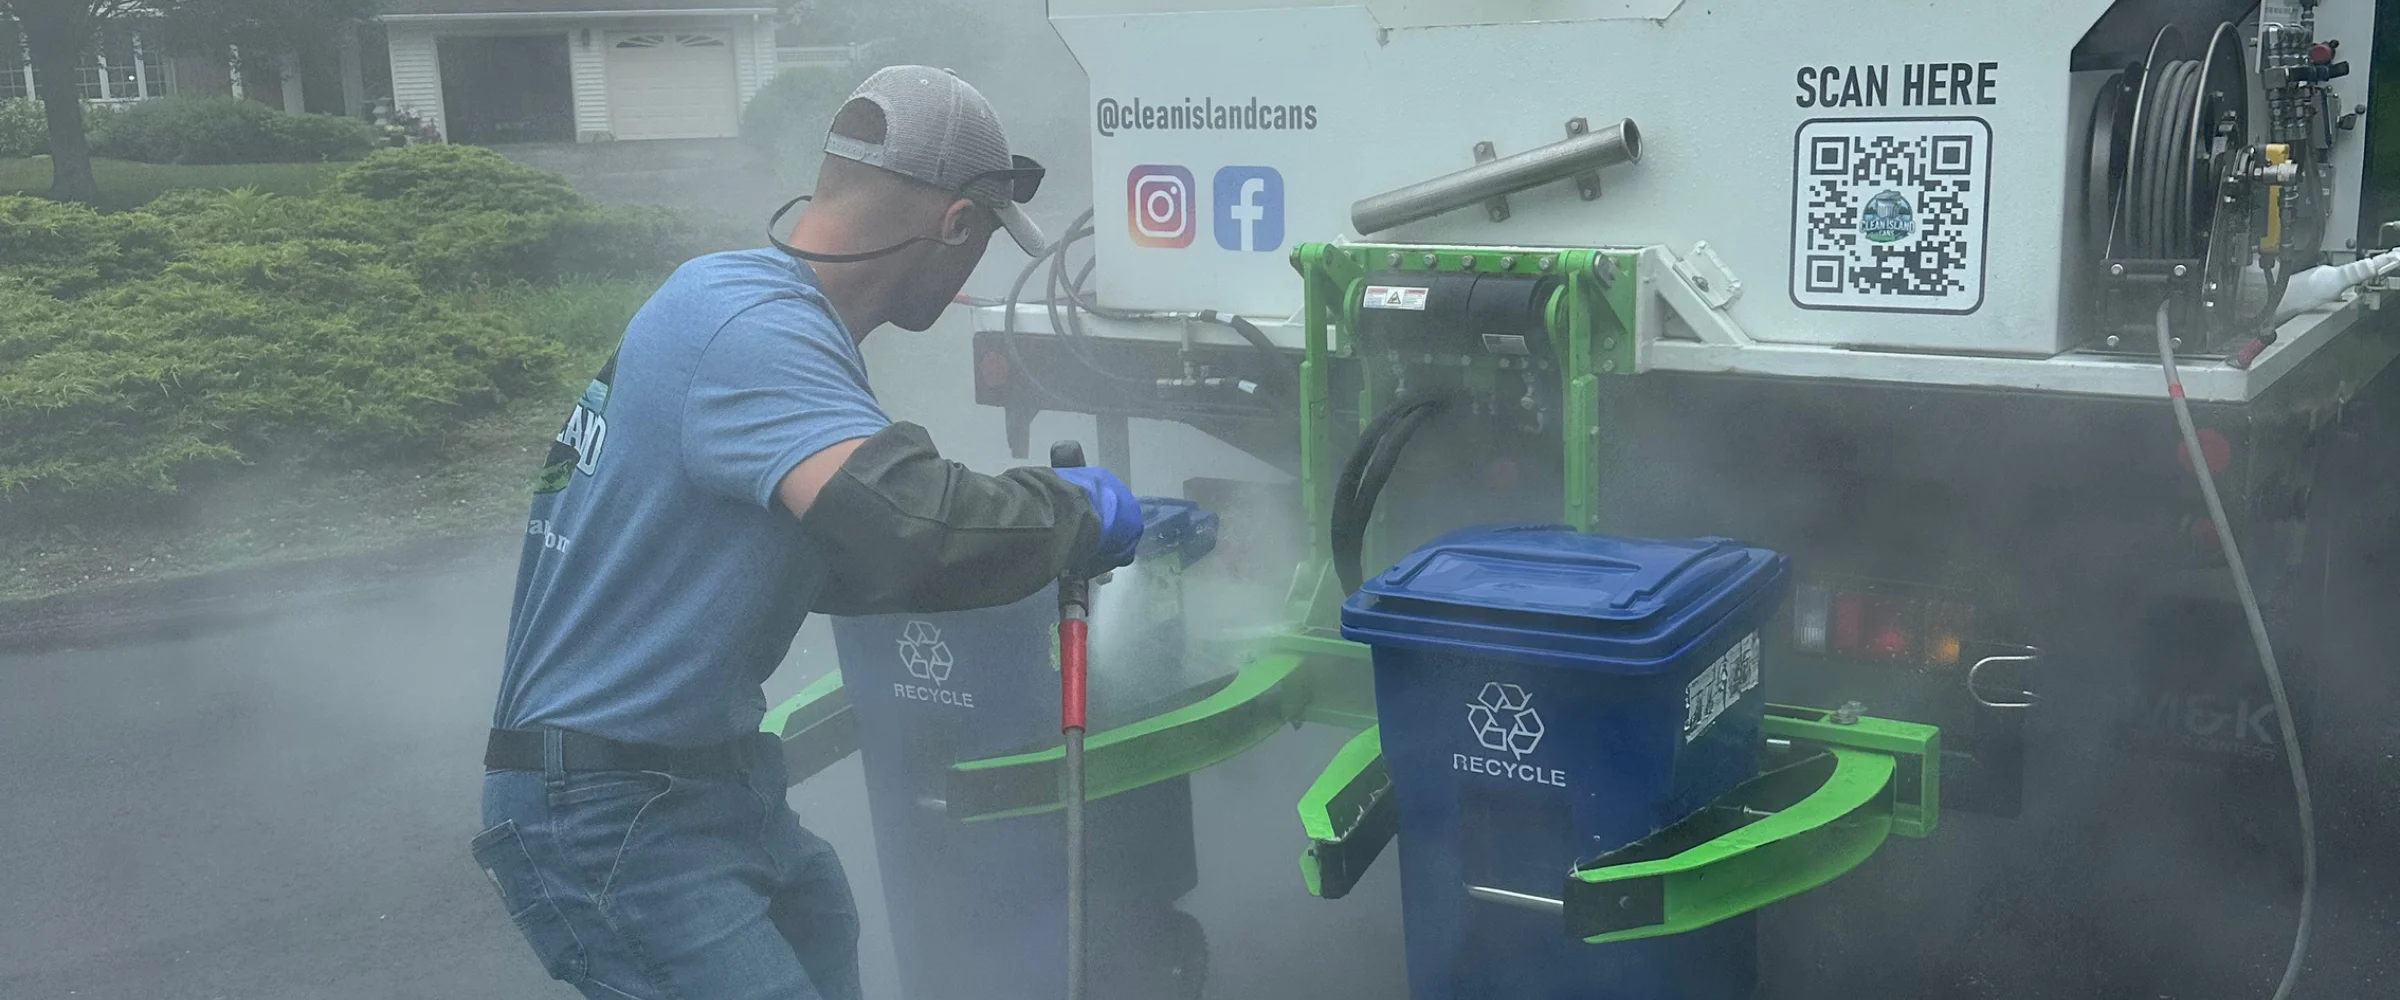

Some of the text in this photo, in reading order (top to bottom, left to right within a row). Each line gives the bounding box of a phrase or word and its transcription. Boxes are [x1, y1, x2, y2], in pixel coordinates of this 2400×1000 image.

[1796, 62, 1998, 108] SCAN HERE
[1097, 97, 1318, 137] @cleanislandcans
[1860, 219, 1915, 233] CLEAN ISLAND
[893, 683, 975, 708] RECYCLE
[1453, 753, 1566, 788] RECYCLE
